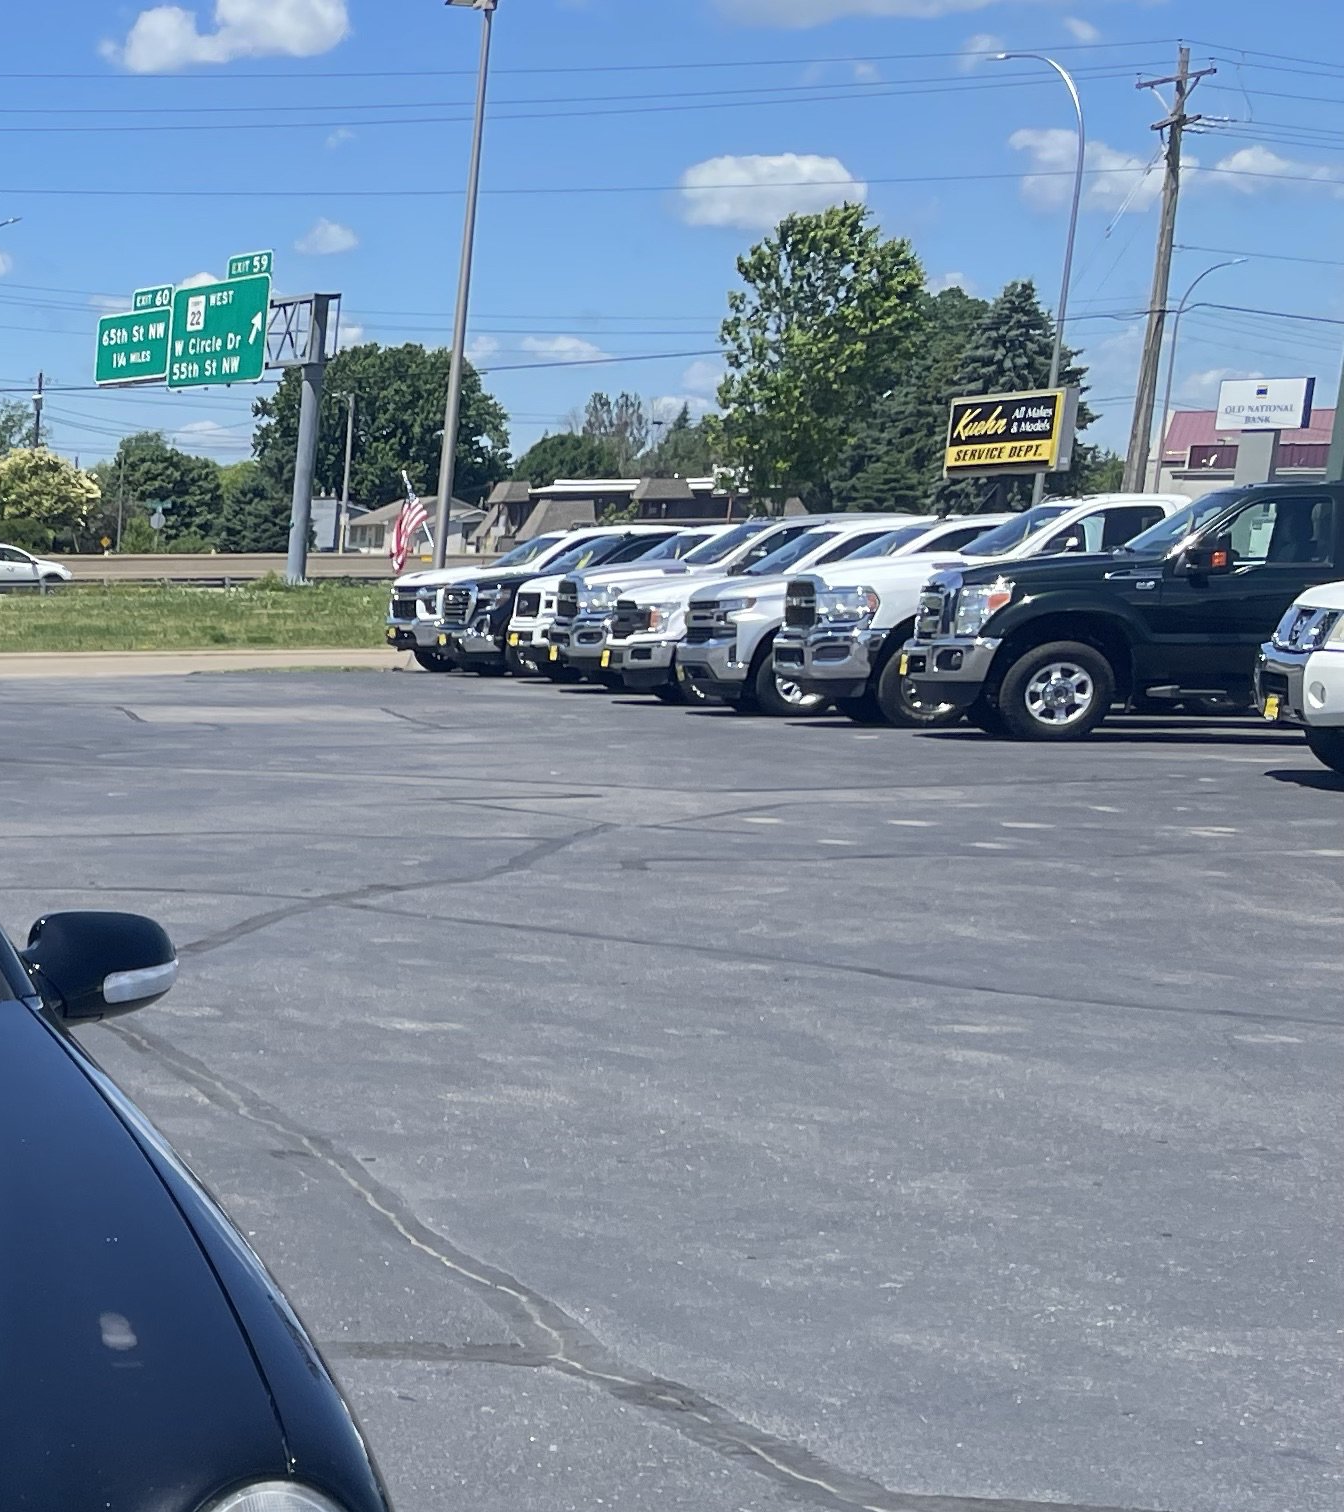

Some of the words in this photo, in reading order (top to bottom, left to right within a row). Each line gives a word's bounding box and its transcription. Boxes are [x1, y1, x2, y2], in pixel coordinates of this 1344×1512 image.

[231, 260, 251, 275] EXIT
[252, 255, 269, 273] 59
[136, 294, 153, 307] EXIT
[155, 289, 170, 306] 60
[209, 290, 234, 307] WEST
[189, 310, 202, 327] 22
[102, 328, 128, 347] 65th
[132, 325, 145, 343] St
[148, 322, 166, 340] NW
[174, 340, 184, 357] W
[188, 335, 223, 355] Circle
[227, 332, 242, 350] Dr
[129, 350, 151, 364] MILES
[172, 362, 199, 380] 55th
[204, 358, 217, 377] St
[222, 356, 240, 375] NW
[1012, 406, 1026, 420] All
[1026, 405, 1053, 418] Makes
[1224, 405, 1245, 415] OLD
[1247, 404, 1296, 413] NATIONAL
[952, 405, 1008, 441] Kuehn
[1010, 421, 1018, 434] &
[1019, 419, 1051, 433] Models
[1244, 415, 1272, 425] BANK
[954, 445, 1006, 462] SERVICE
[1008, 443, 1043, 458] DEPT.
